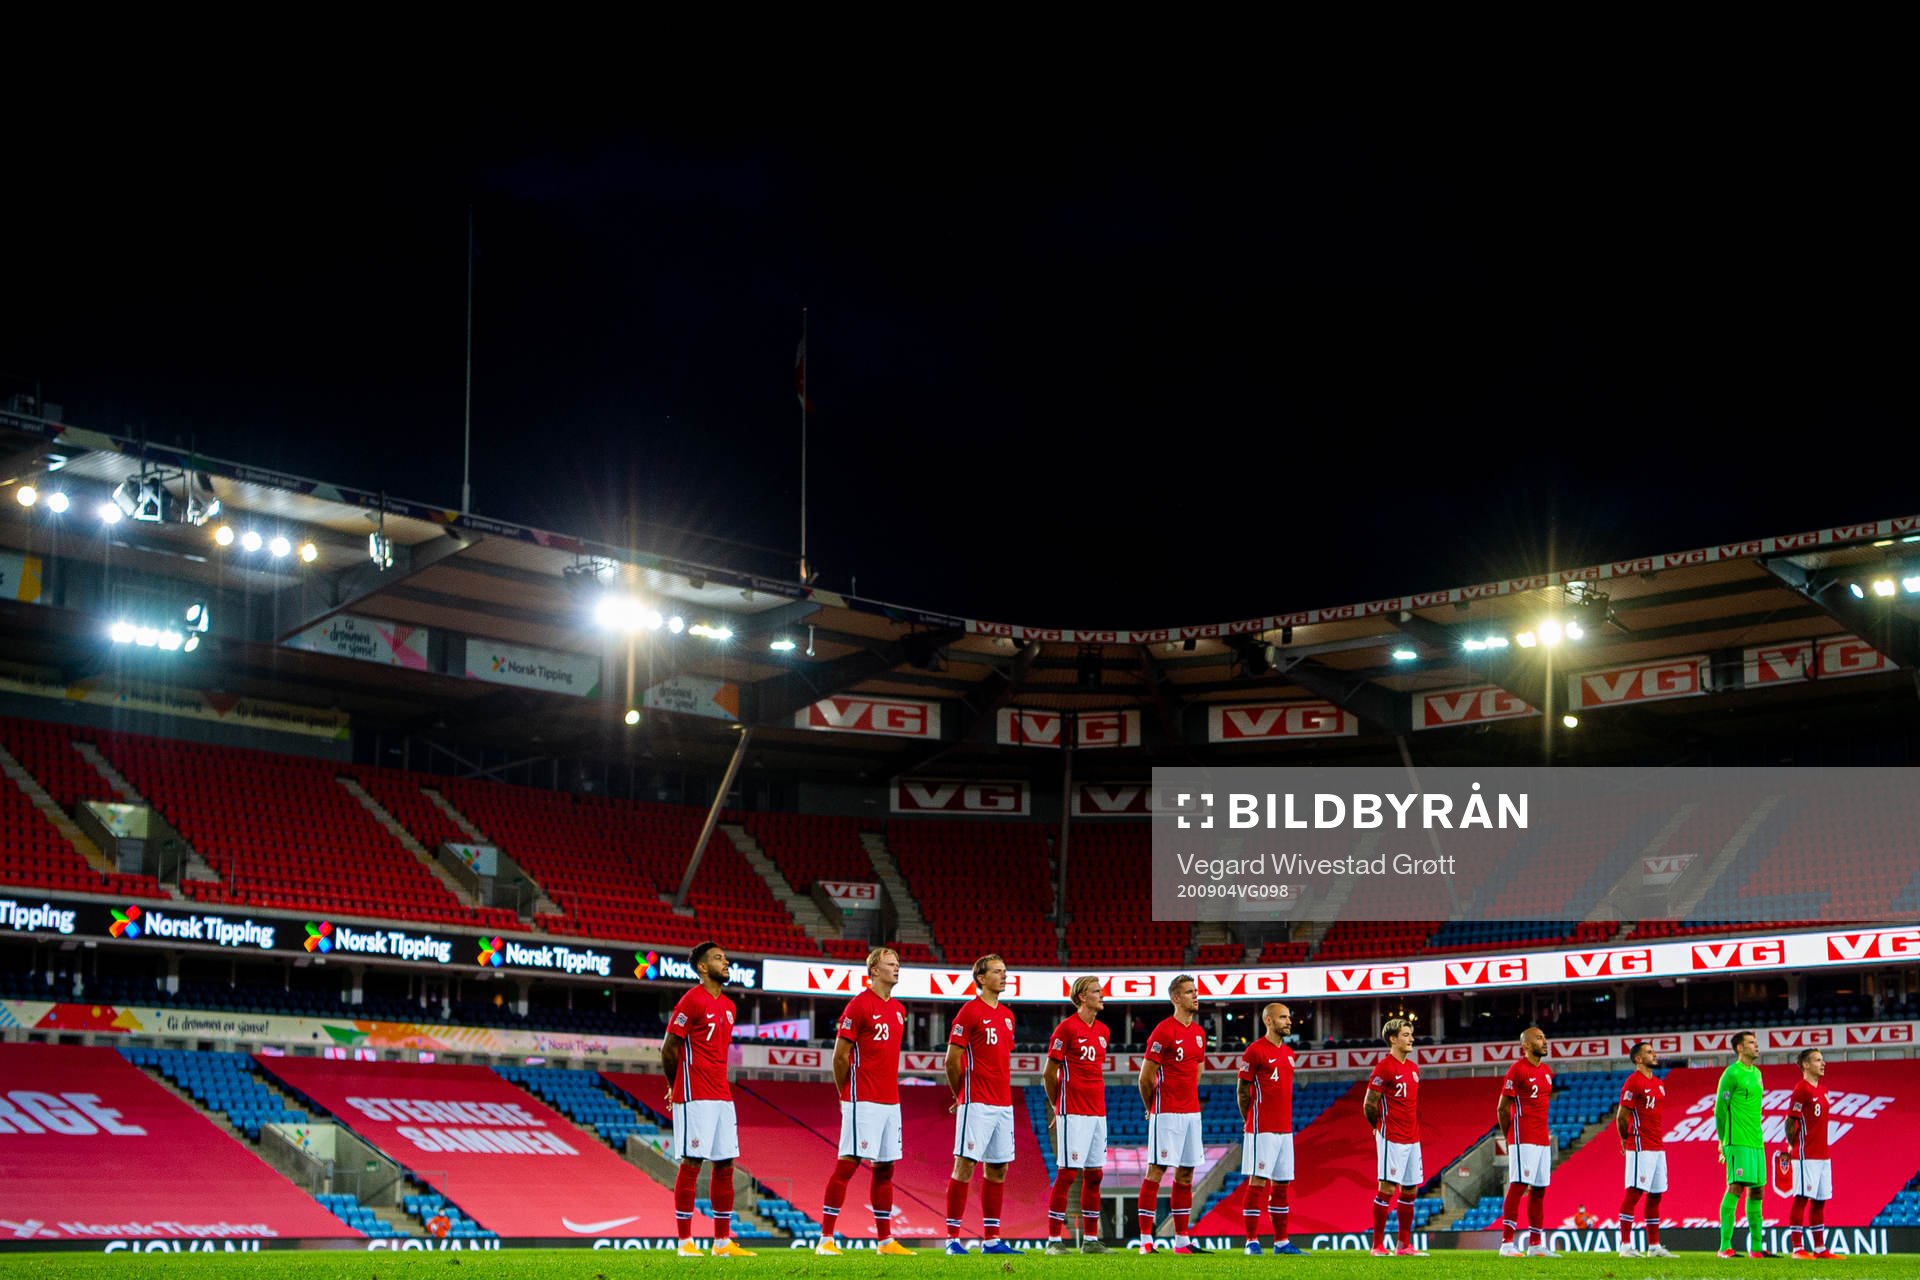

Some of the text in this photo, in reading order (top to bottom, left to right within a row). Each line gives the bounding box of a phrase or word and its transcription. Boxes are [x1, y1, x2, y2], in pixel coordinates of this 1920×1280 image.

[1892, 517, 1920, 531] V
[507, 660, 574, 684] Norsk Tipping
[1762, 643, 1877, 680] VG
[1585, 665, 1692, 702] VG
[1426, 689, 1526, 722] VG
[815, 700, 921, 733] VG
[1227, 706, 1337, 737] VG
[1014, 713, 1120, 744] VG
[904, 783, 1015, 810] VG
[824, 884, 872, 898] VG
[145, 911, 203, 939] Norsk
[203, 916, 276, 949] Tipping
[335, 927, 389, 954] Norsk
[388, 931, 452, 963] Tipping
[505, 942, 553, 968] Norsk
[553, 946, 611, 976] Tipping
[660, 956, 700, 979] Nors
[1200, 972, 1285, 995] VG
[1329, 967, 1406, 992] VG
[1447, 959, 1525, 985] VG
[1567, 950, 1649, 978] VG
[1694, 940, 1781, 969] VG
[1829, 932, 1920, 961] VG
[706, 1023, 716, 1041] 7
[873, 1023, 889, 1041] 23
[985, 1028, 998, 1045] 15
[771, 1050, 818, 1065] VG
[1420, 1047, 1471, 1064] VG
[1554, 1040, 1607, 1058] VG
[1771, 1029, 1830, 1047] VG
[1849, 1025, 1910, 1043] VG
[1080, 1045, 1096, 1061] 20
[1175, 1047, 1184, 1061] 3
[1270, 1067, 1280, 1082] 4
[1394, 1083, 1408, 1098] 21
[1530, 1084, 1539, 1099] 2
[346, 1096, 547, 1127] STERKERE
[1645, 1095, 1656, 1110] 14
[1814, 1103, 1821, 1117] 8
[396, 1126, 580, 1156] SAMMEN
[58, 1220, 279, 1238] Norsk Tipping
